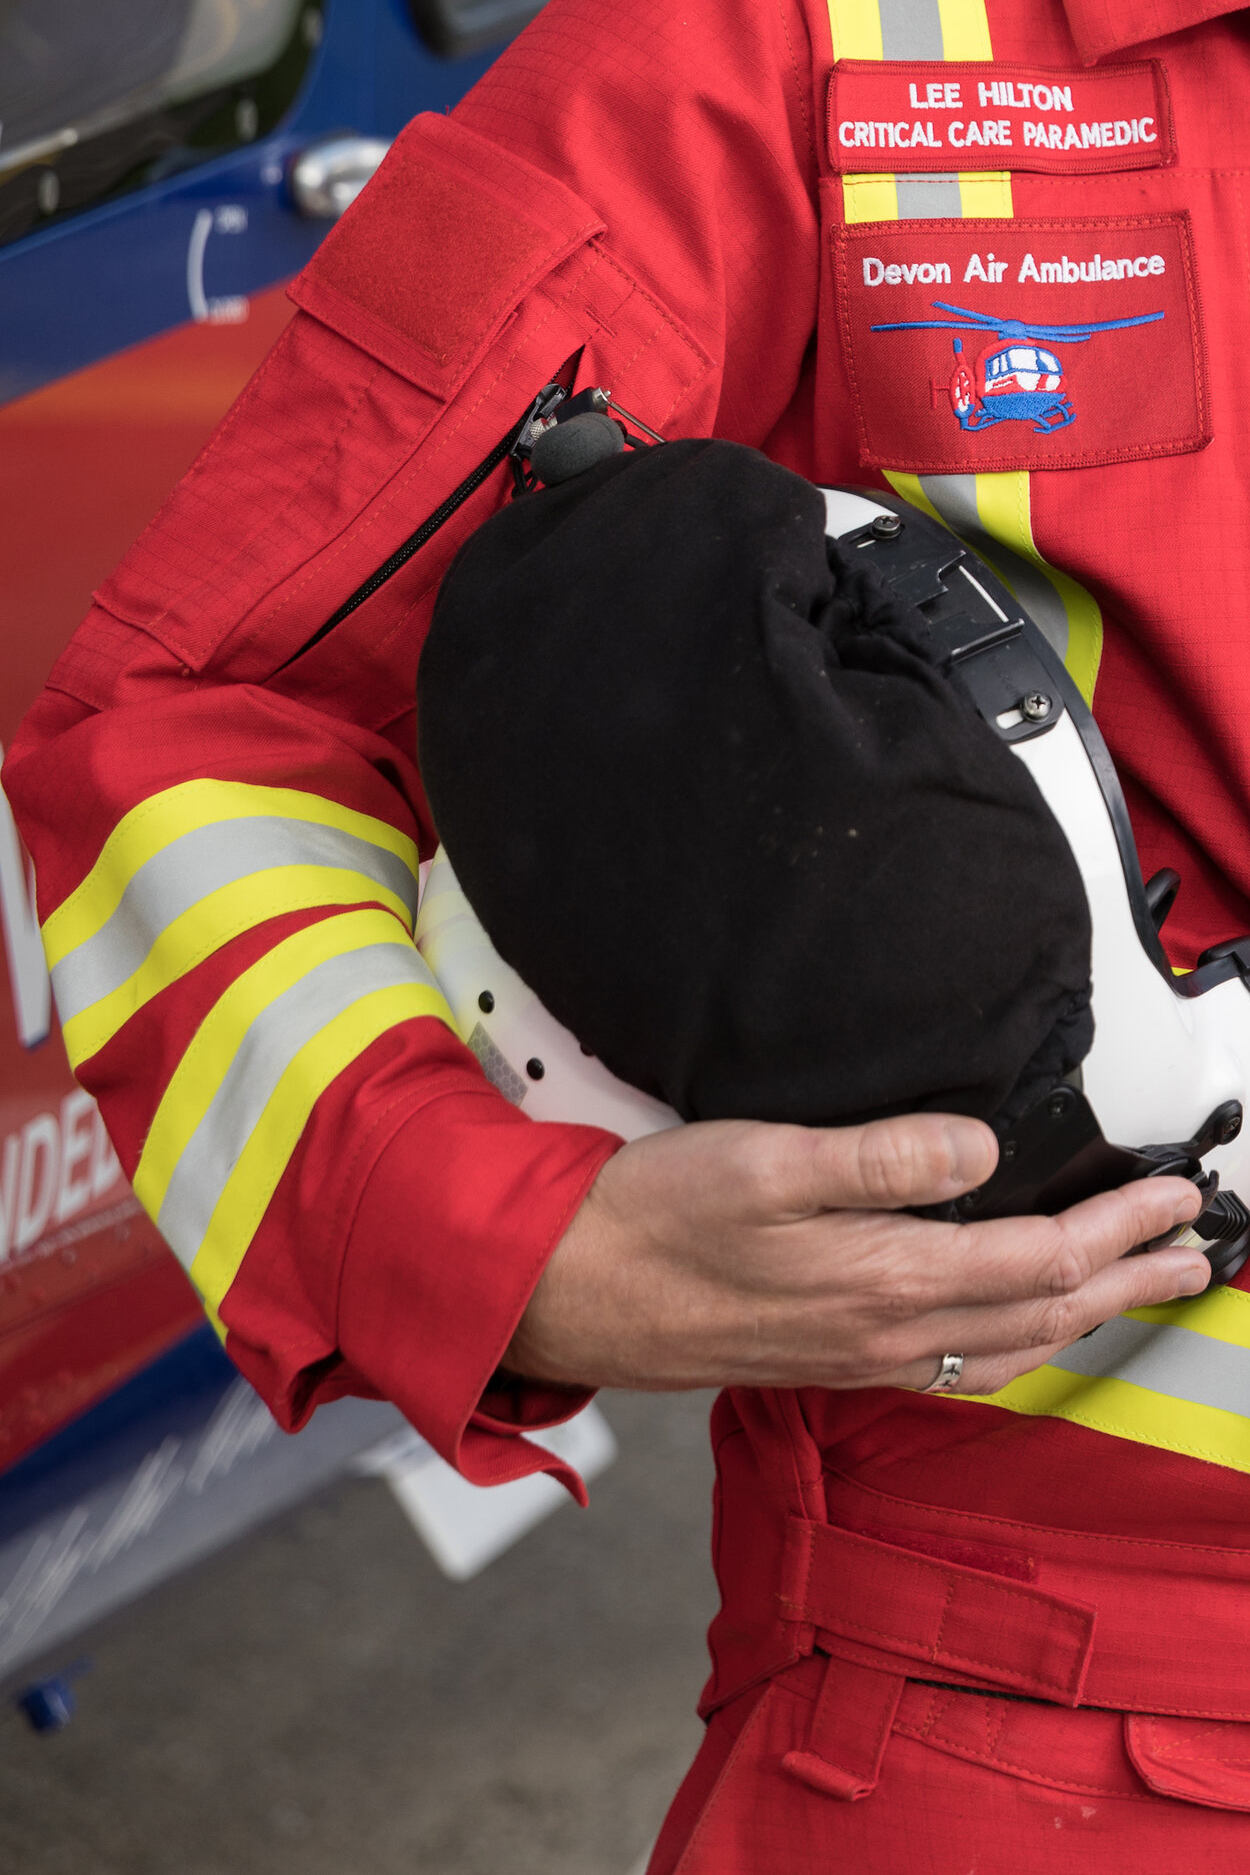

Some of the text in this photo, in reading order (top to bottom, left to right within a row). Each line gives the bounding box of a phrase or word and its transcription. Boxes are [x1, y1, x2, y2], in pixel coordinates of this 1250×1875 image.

[909, 82, 1075, 112] LEE HILTON
[839, 117, 1158, 150] CRITICAL CARE PARAMEDIC
[863, 253, 1166, 287] Devon Air Ambulance
